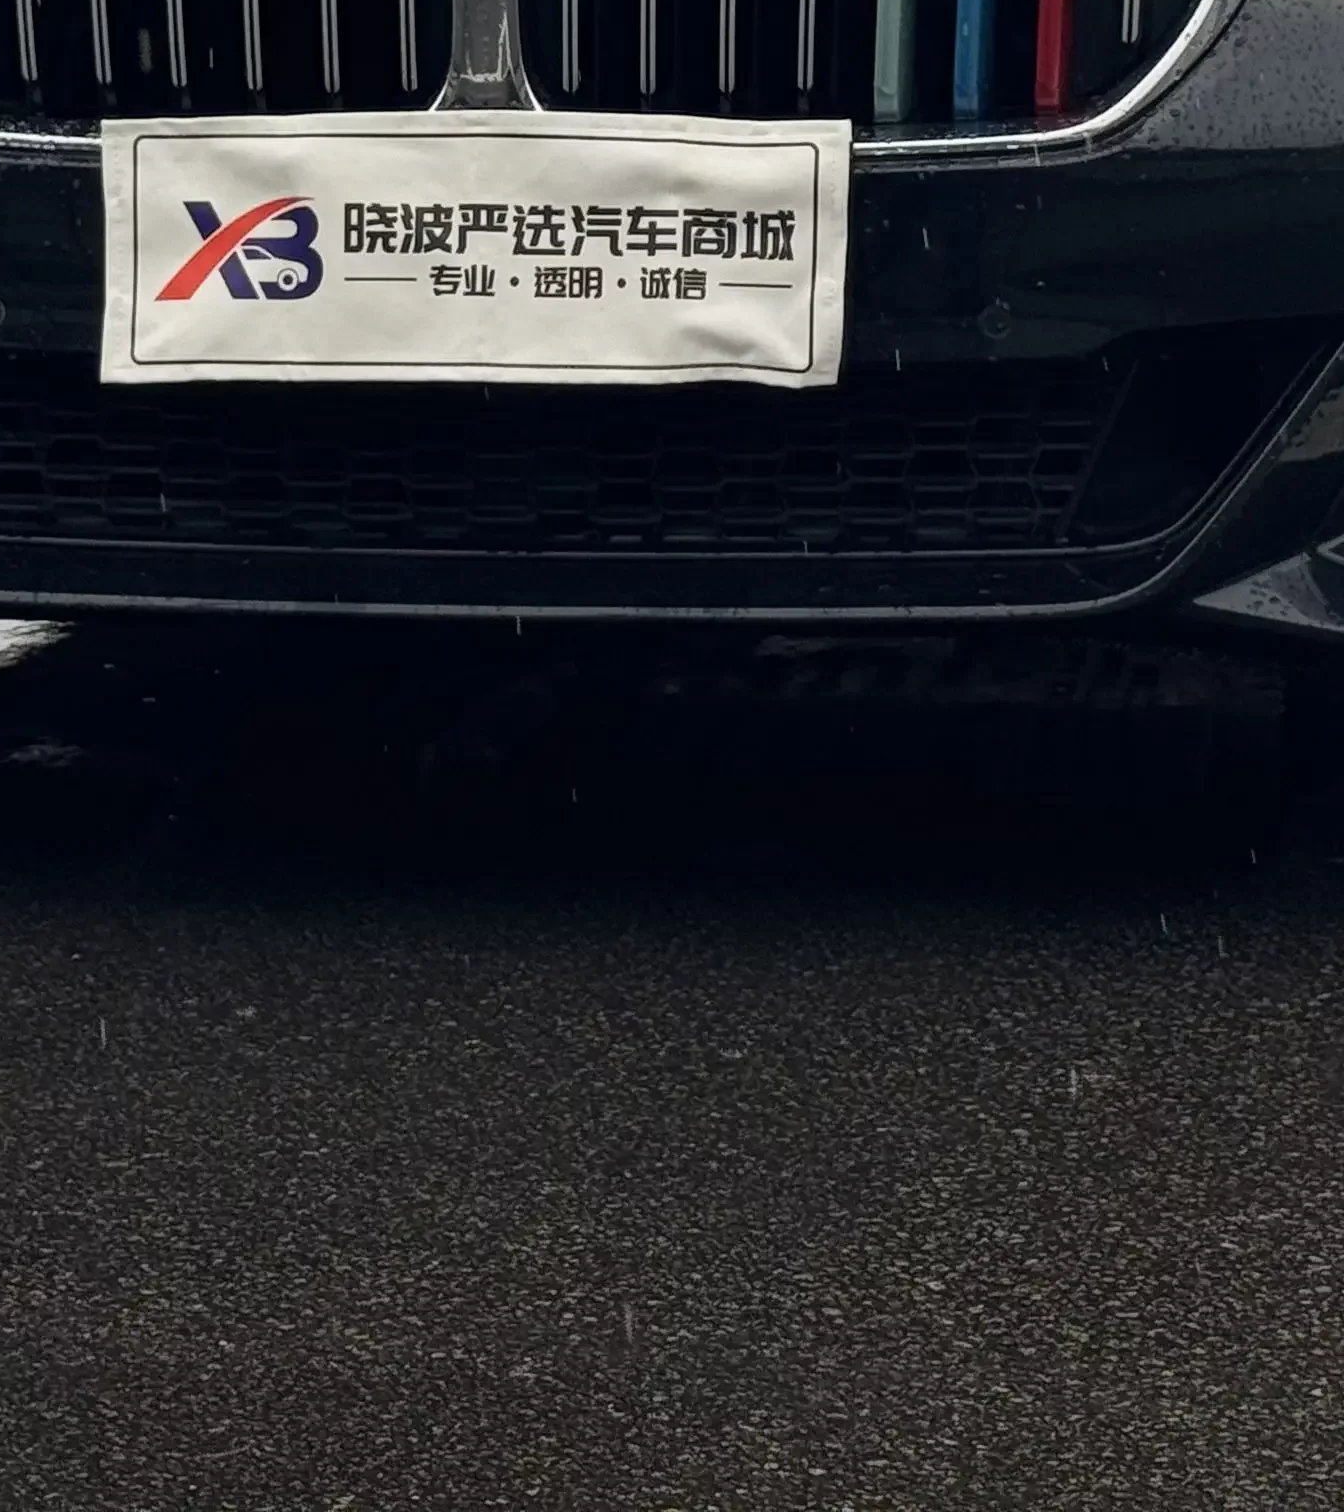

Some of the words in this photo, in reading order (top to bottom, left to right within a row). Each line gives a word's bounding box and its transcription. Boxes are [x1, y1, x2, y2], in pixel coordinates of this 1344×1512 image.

[343, 202, 796, 261] 晓波严选汽车商城
